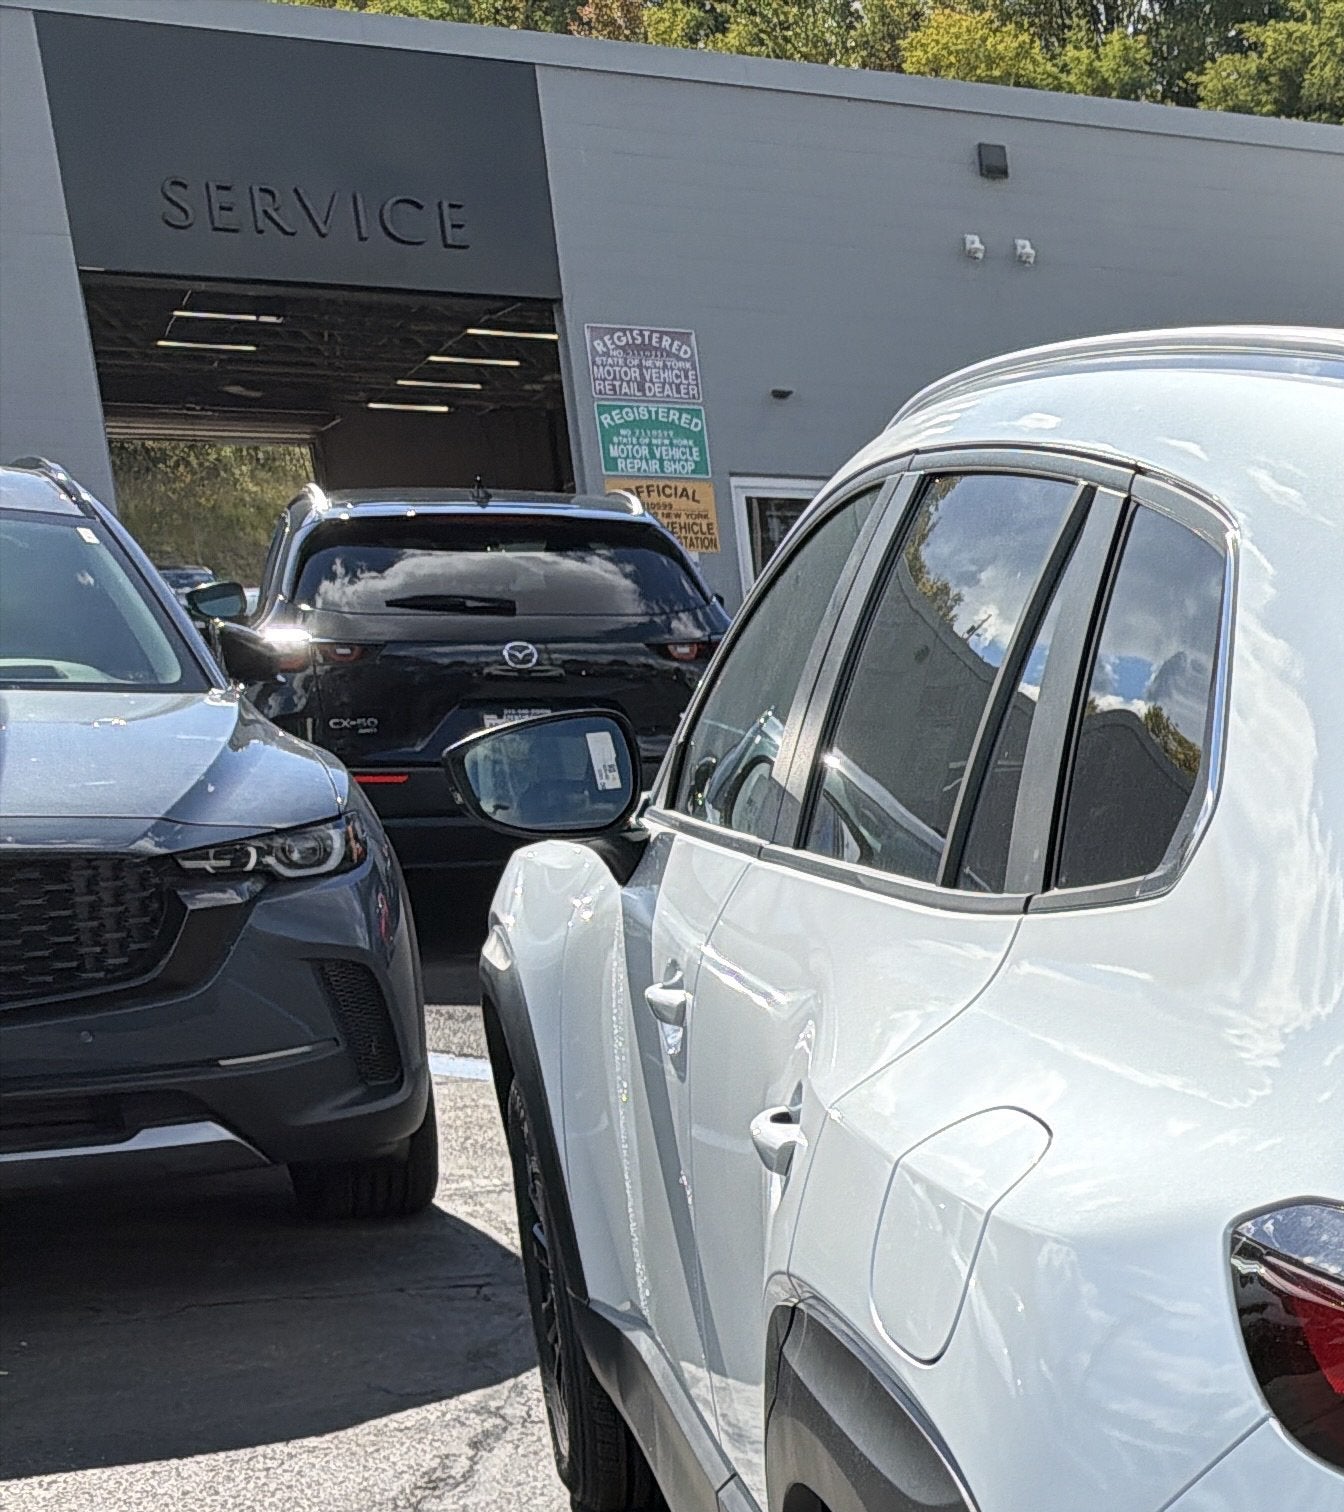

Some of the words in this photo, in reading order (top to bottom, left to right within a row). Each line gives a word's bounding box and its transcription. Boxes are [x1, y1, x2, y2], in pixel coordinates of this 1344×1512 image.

[160, 176, 471, 250] SERVICE
[593, 330, 692, 359] REGISTERED
[595, 357, 624, 367] STATE
[627, 358, 640, 367] OF
[642, 359, 663, 368] NEW
[665, 360, 692, 370] YORK
[594, 366, 640, 382] MOTOR
[643, 367, 697, 384] VEHICLE
[595, 380, 642, 396] RETAIL
[645, 382, 699, 399] DEALER
[600, 406, 702, 432] REGISTERED
[612, 436, 637, 445] STATE
[639, 437, 650, 445] OF
[672, 439, 694, 447] YORK
[609, 444, 650, 459] MOTOR
[653, 445, 700, 461] VEHICLE
[617, 458, 661, 473] REPAIR
[664, 460, 695, 474] SHOP
[661, 511, 682, 519] NEW
[684, 512, 710, 520] YORK
[329, 717, 379, 729] CX-50
